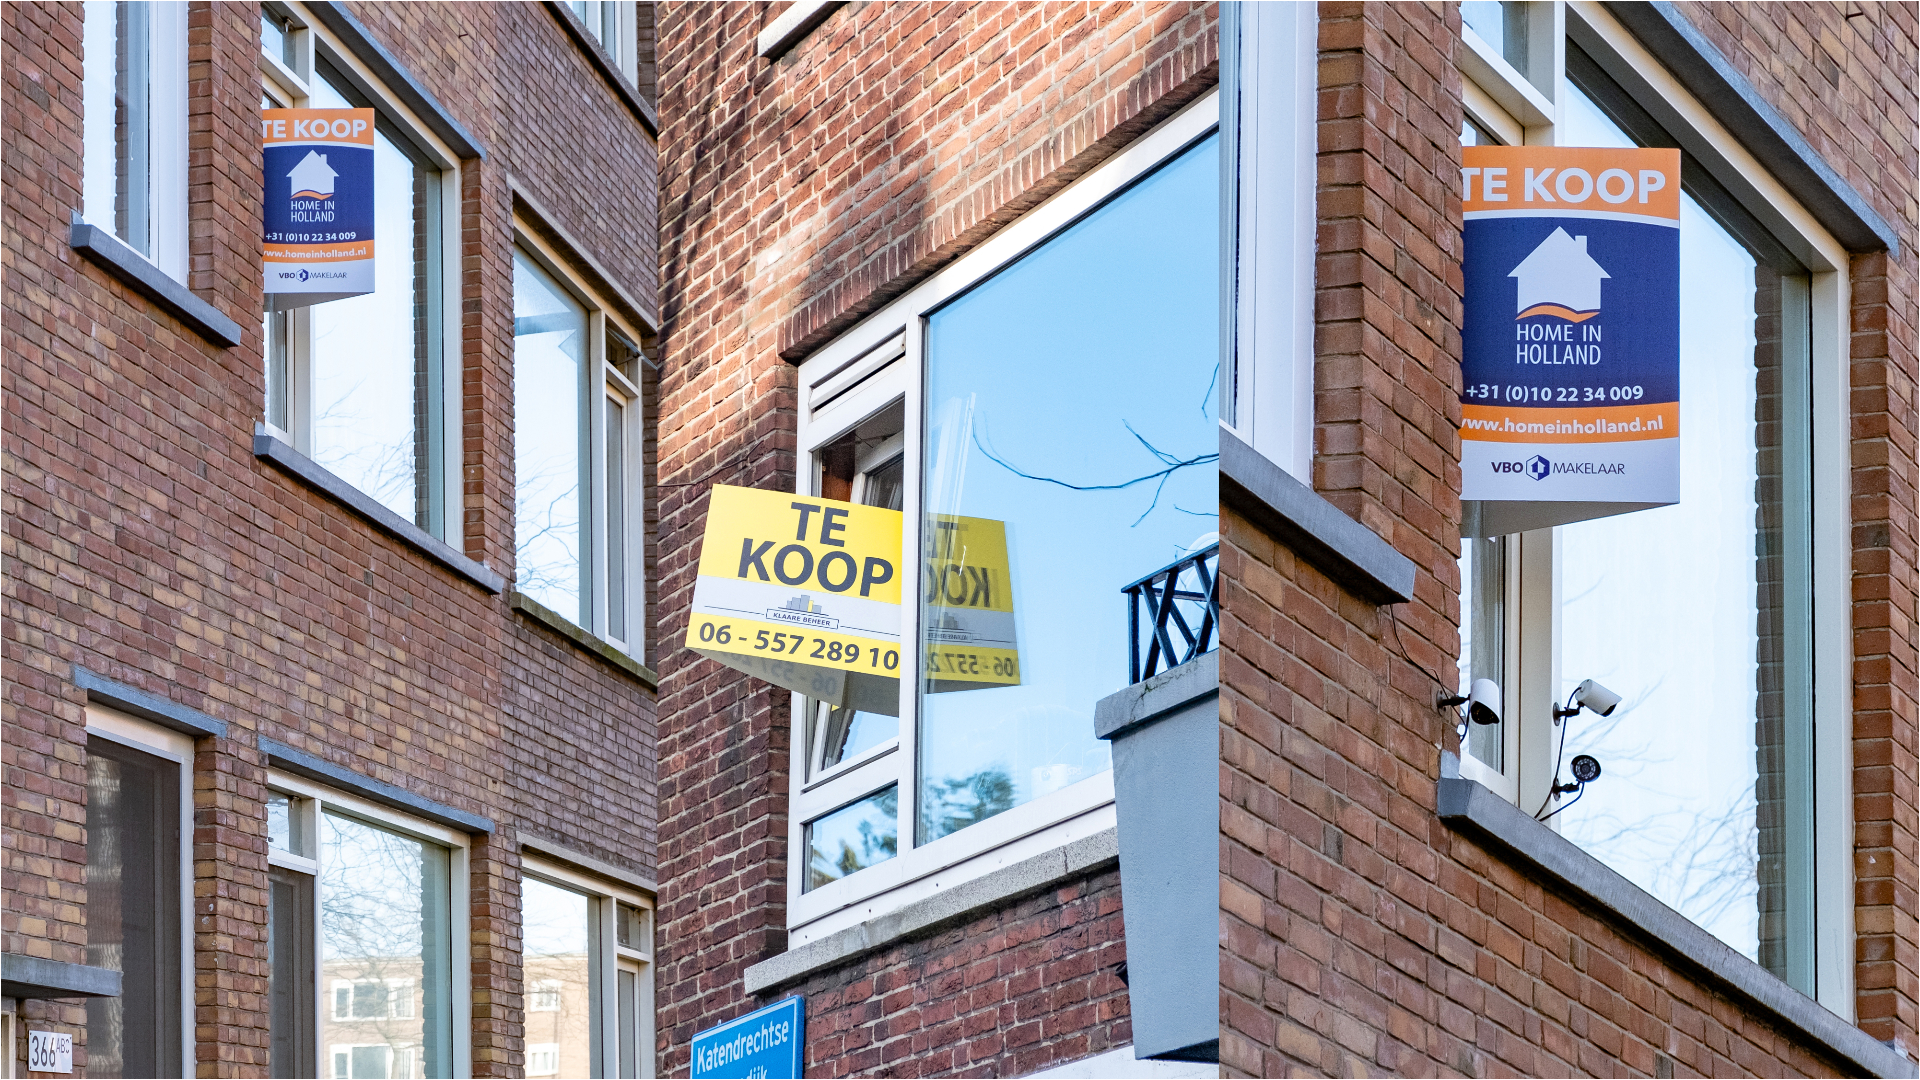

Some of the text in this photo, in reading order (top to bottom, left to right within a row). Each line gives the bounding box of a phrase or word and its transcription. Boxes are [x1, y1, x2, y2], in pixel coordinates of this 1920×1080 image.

[262, 118, 368, 138] TE KOOP
[1460, 167, 1666, 204] TE KOOP
[290, 200, 335, 211] HOME IN
[290, 211, 335, 222] HOLLAND
[265, 231, 357, 243] +31 (0)10 22 34 009
[264, 246, 367, 259] ww.homeinholland.nl
[309, 271, 348, 279] MAKELAAR
[1516, 323, 1602, 342] HOME IN
[1516, 343, 1601, 365] HOLLAND
[1466, 384, 1644, 403] +31 (0)10 22 34 009
[1490, 461, 1626, 475] VBO MAKELAAR
[790, 501, 850, 548] TE
[737, 537, 894, 598] KOOP
[772, 612, 831, 627] KLAARE BEHEER
[699, 621, 732, 645] 06
[753, 629, 805, 656] 557
[809, 638, 860, 664] 289
[869, 647, 899, 670] 10
[696, 1020, 789, 1075] Katendrechtse
